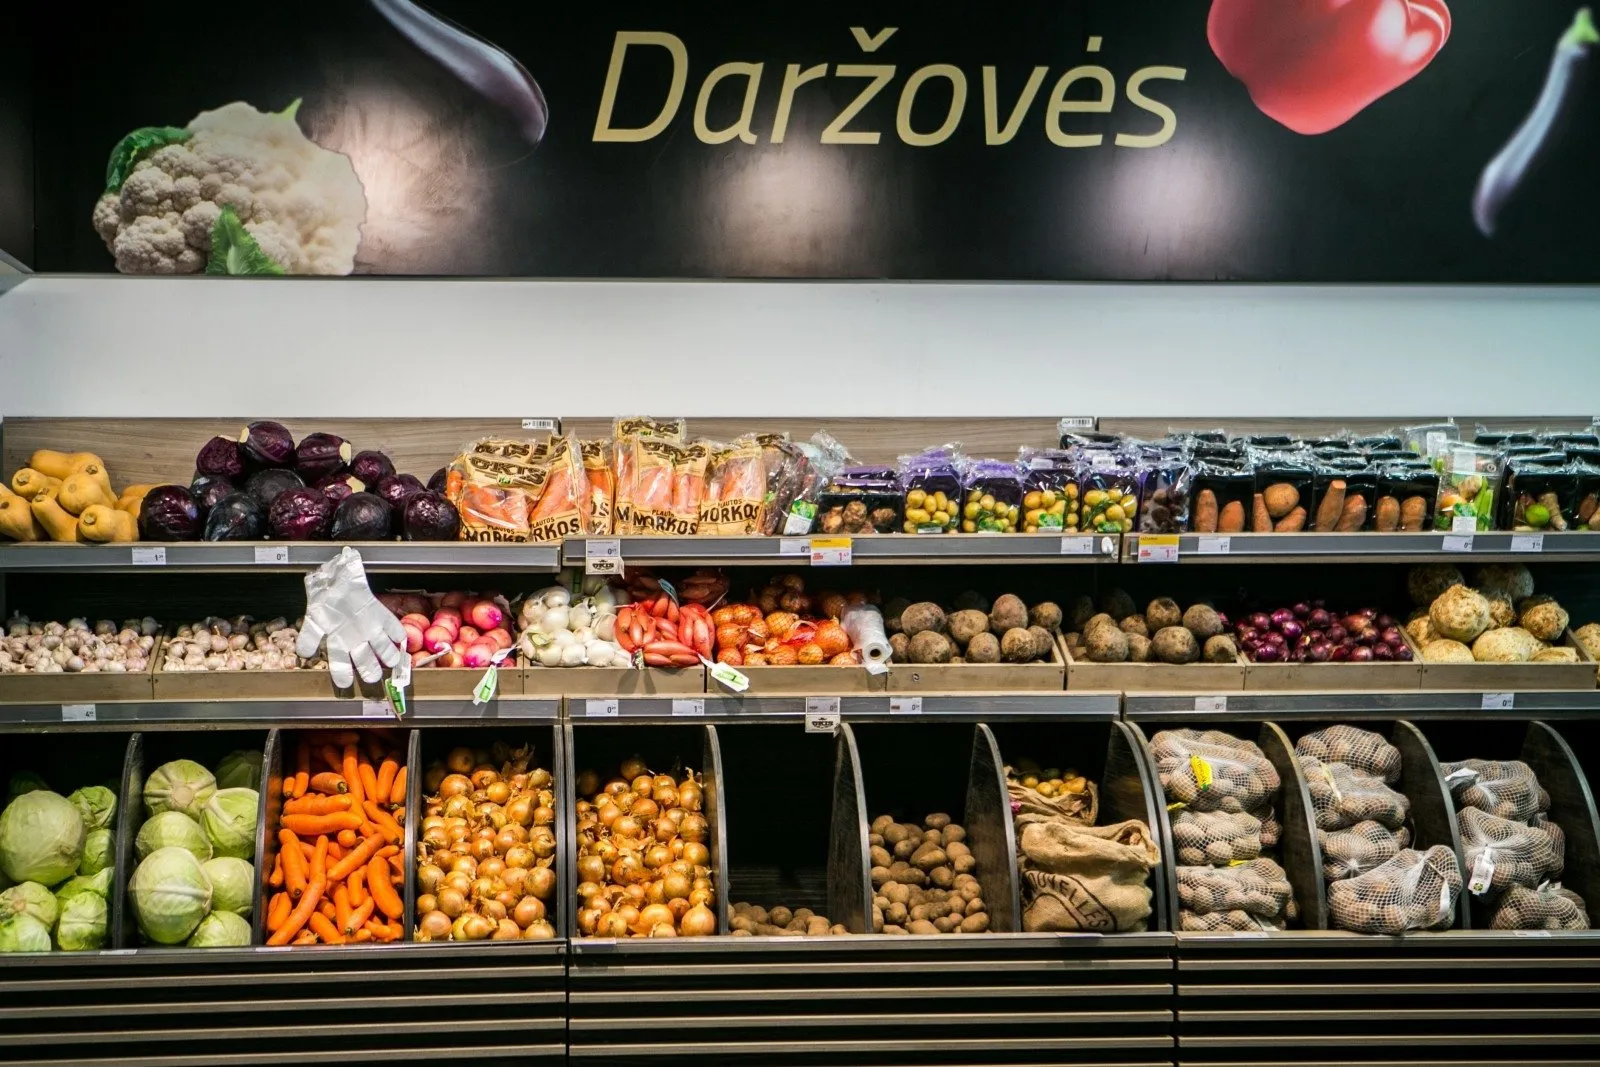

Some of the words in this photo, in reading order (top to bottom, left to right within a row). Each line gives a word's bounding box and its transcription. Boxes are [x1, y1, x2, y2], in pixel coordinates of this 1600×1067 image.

[592, 27, 1187, 148] Daržovės
[532, 517, 555, 529] LAUTOS
[533, 518, 580, 542] RKOS
